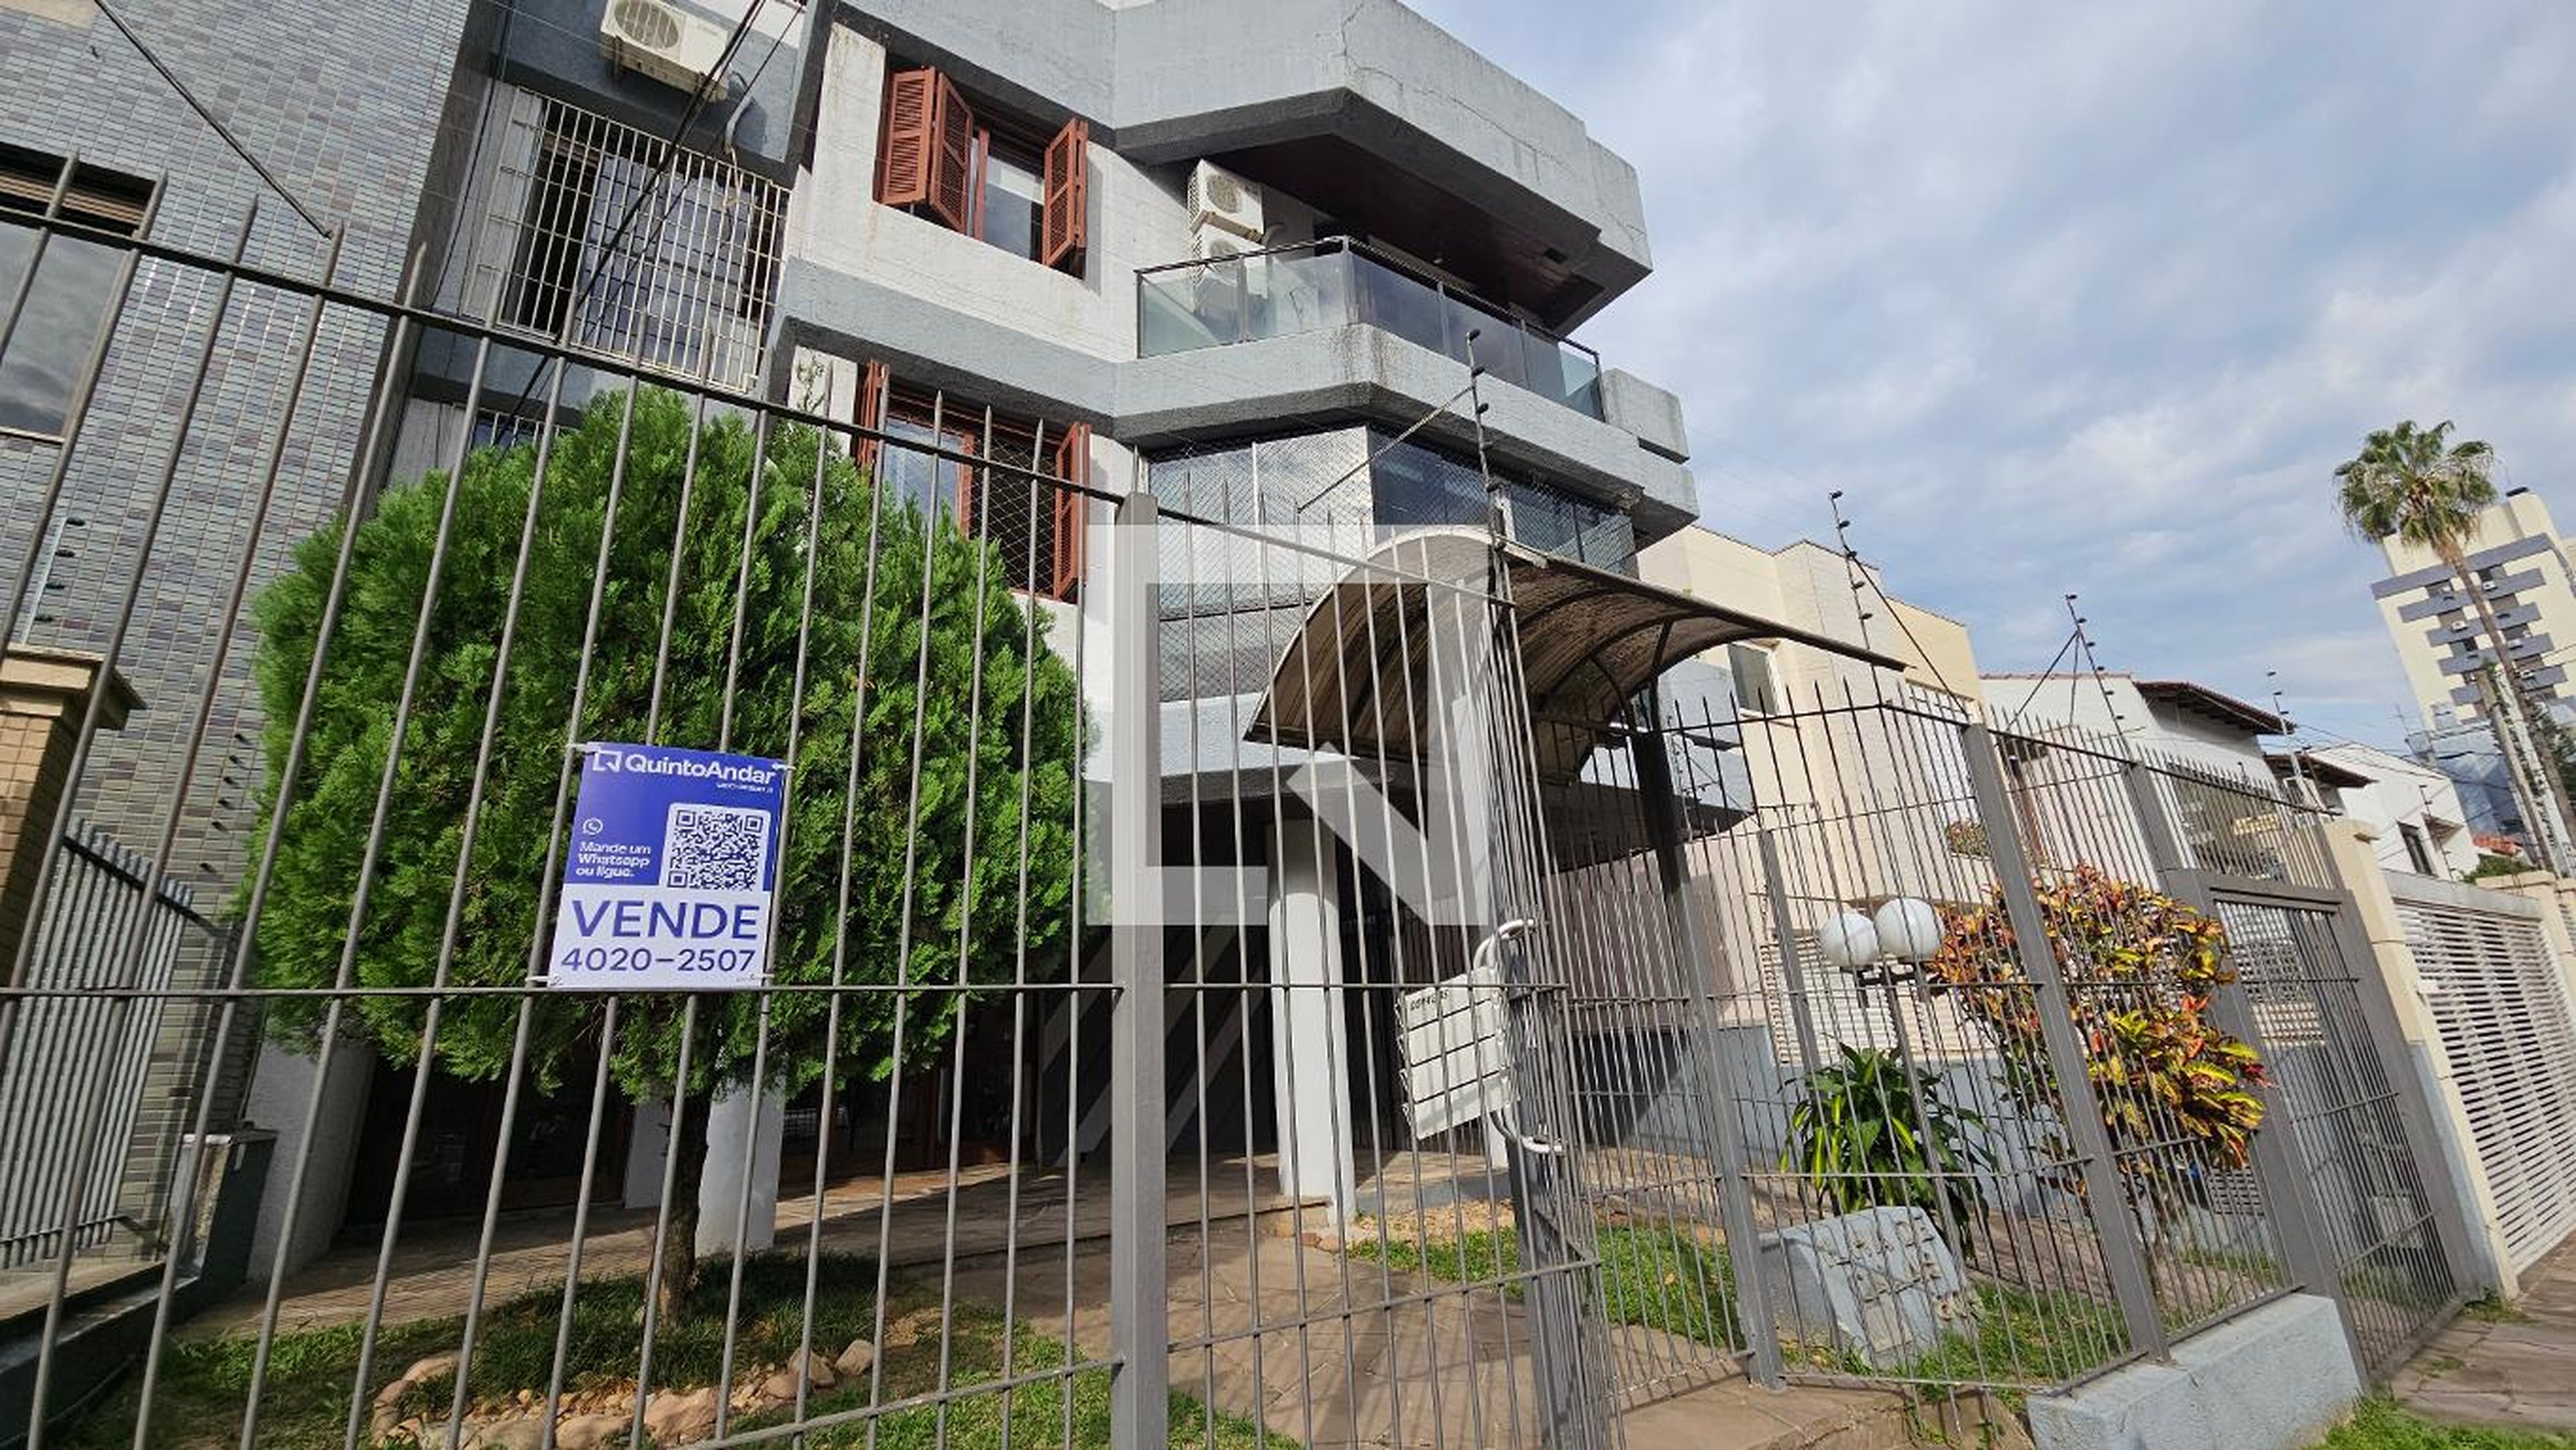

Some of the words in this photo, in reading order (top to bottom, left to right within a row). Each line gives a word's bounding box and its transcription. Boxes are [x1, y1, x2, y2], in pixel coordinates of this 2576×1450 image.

[625, 754, 776, 785] QuintoAndar
[580, 842, 628, 854] Mande
[629, 845, 651, 854] um
[578, 853, 650, 868] Whatsapp
[576, 868, 594, 876] ou
[571, 900, 760, 940] VENDE
[561, 947, 756, 971] 4020-2507
